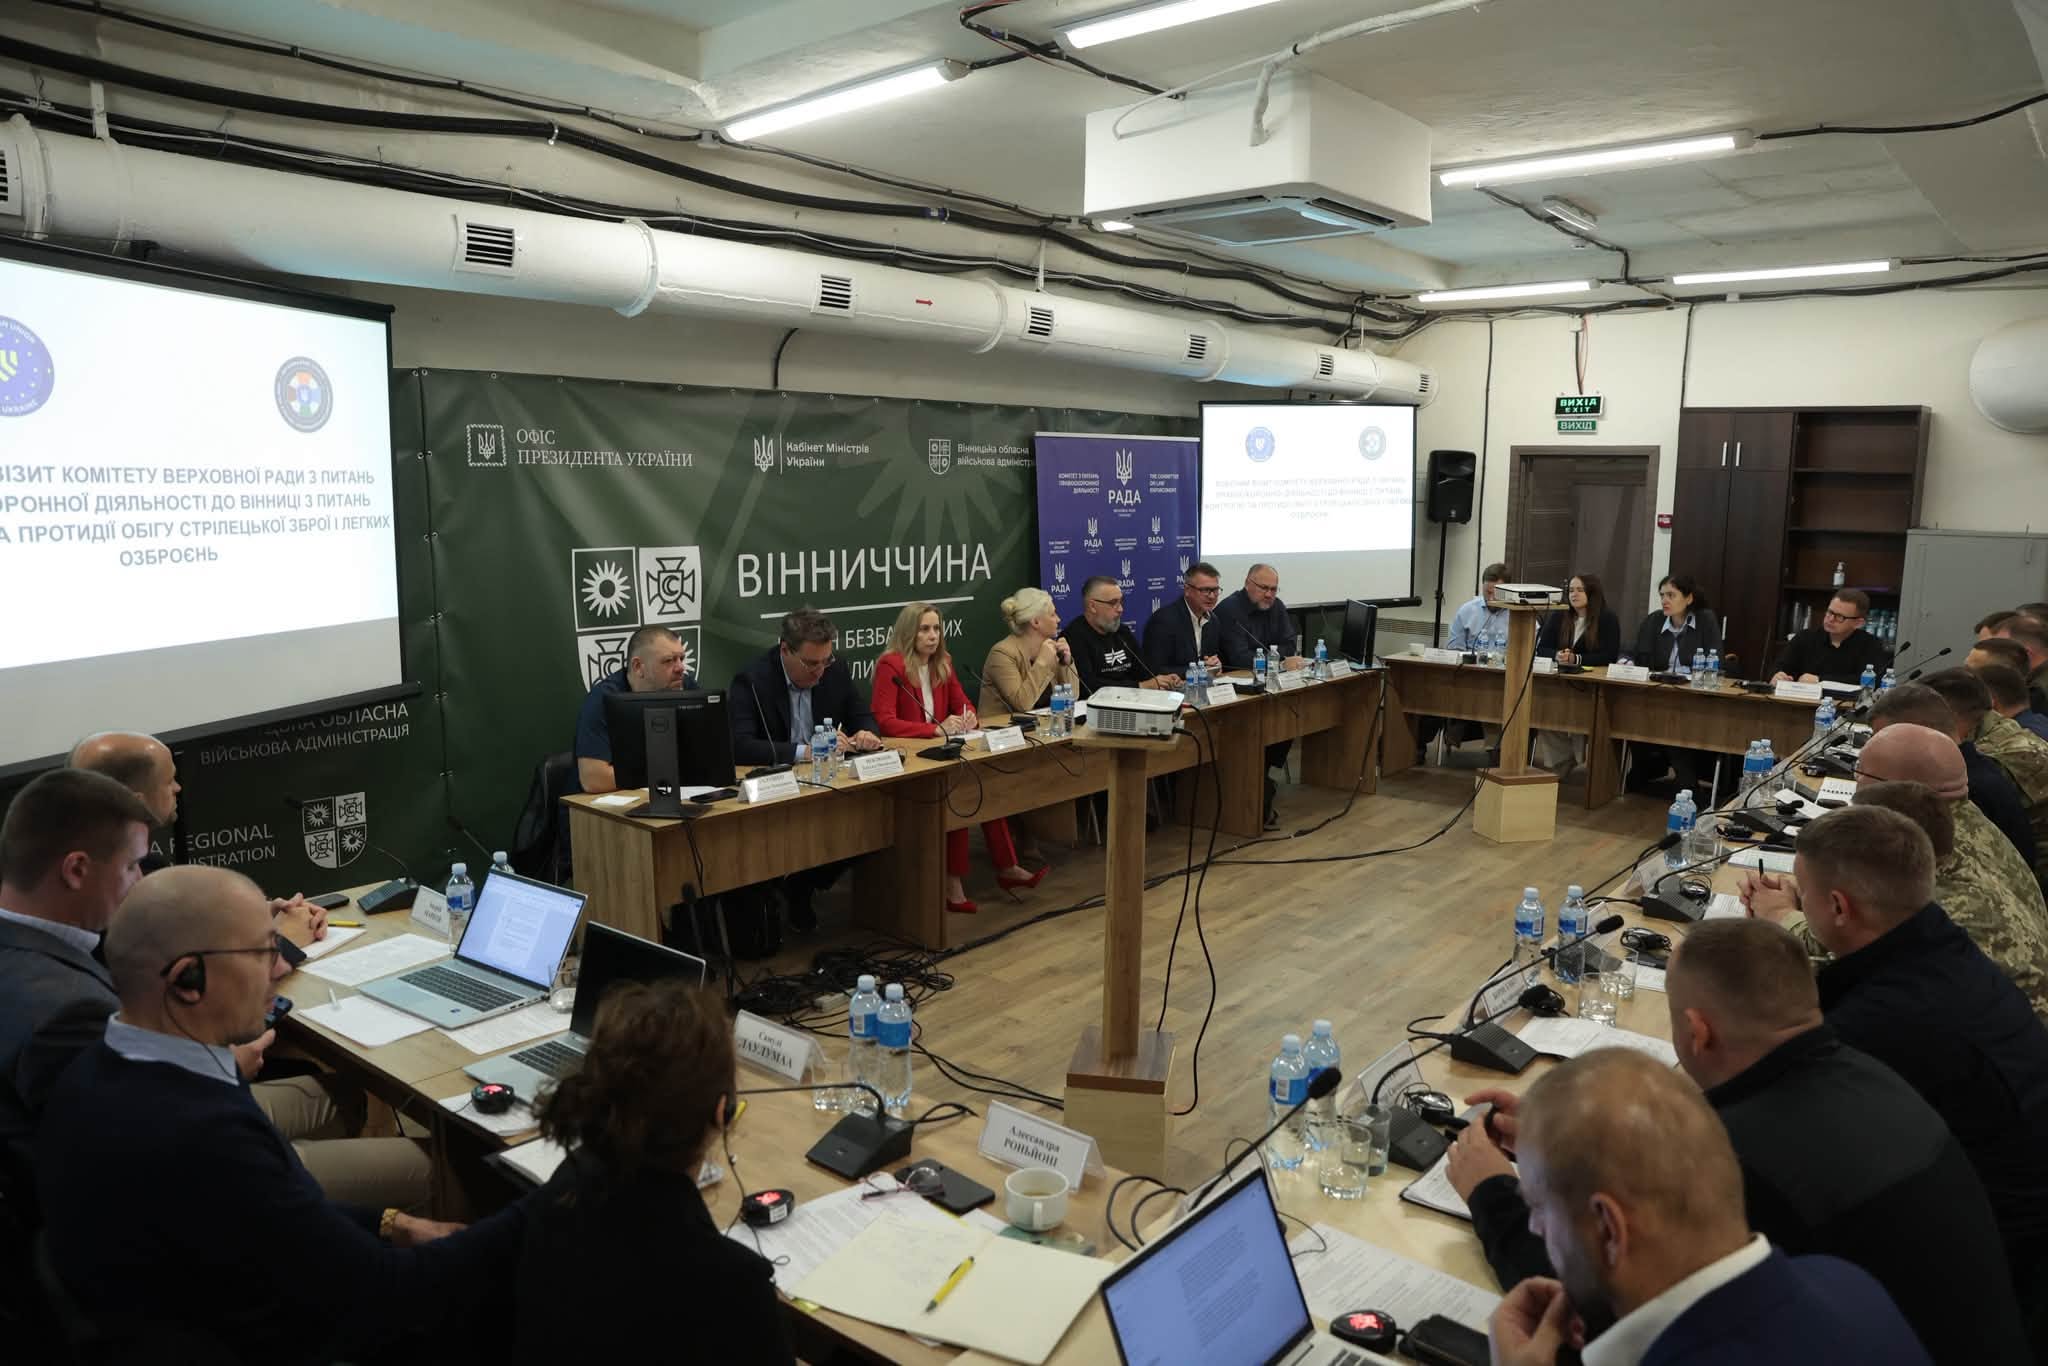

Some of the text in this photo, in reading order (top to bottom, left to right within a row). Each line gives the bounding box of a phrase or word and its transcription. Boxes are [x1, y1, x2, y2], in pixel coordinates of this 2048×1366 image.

[1560, 421, 1593, 430] ВИХІД
[516, 429, 555, 445] ОФІС
[786, 442, 869, 455] Кабінет Міністрів
[957, 443, 1029, 455] Вінницька обласна
[517, 450, 693, 468] ПРЕЗИДЕНТА УКРАЇНИ
[786, 456, 825, 469] України
[997, 458, 1033, 468] адміністр
[62, 466, 157, 485] КОМІТЕТУ
[164, 467, 261, 485] ВЕРХОВНОЇ
[265, 469, 305, 486] РАДИ
[321, 470, 375, 485] ПИТАНЬ
[94, 495, 207, 514] ДІЯЛЬНОСТІ
[211, 495, 235, 513] ДО
[240, 494, 301, 511] ВІННИЦІ
[317, 492, 371, 508] ПИТАНЬ
[1108, 490, 1142, 506] РАДА
[18, 519, 116, 544] ПРОТИДІЇ
[121, 521, 174, 540] ОБІГУ
[180, 516, 286, 537] СТРІЛЕЦЬКОЇ
[289, 514, 331, 533] ЗБРОЇ
[342, 515, 391, 531] ЛЕГКИХ
[1084, 539, 1103, 548] РАДА
[1148, 536, 1165, 545] RADA
[120, 547, 218, 567] ОЗБРОЄНЬ
[737, 543, 992, 598] ВІННИЧЧИНА
[1051, 583, 1070, 593] РАДА
[201, 739, 291, 766] ВІЙСЬКОВА
[295, 723, 409, 753] АДМІНІСТРАЦІЯ
